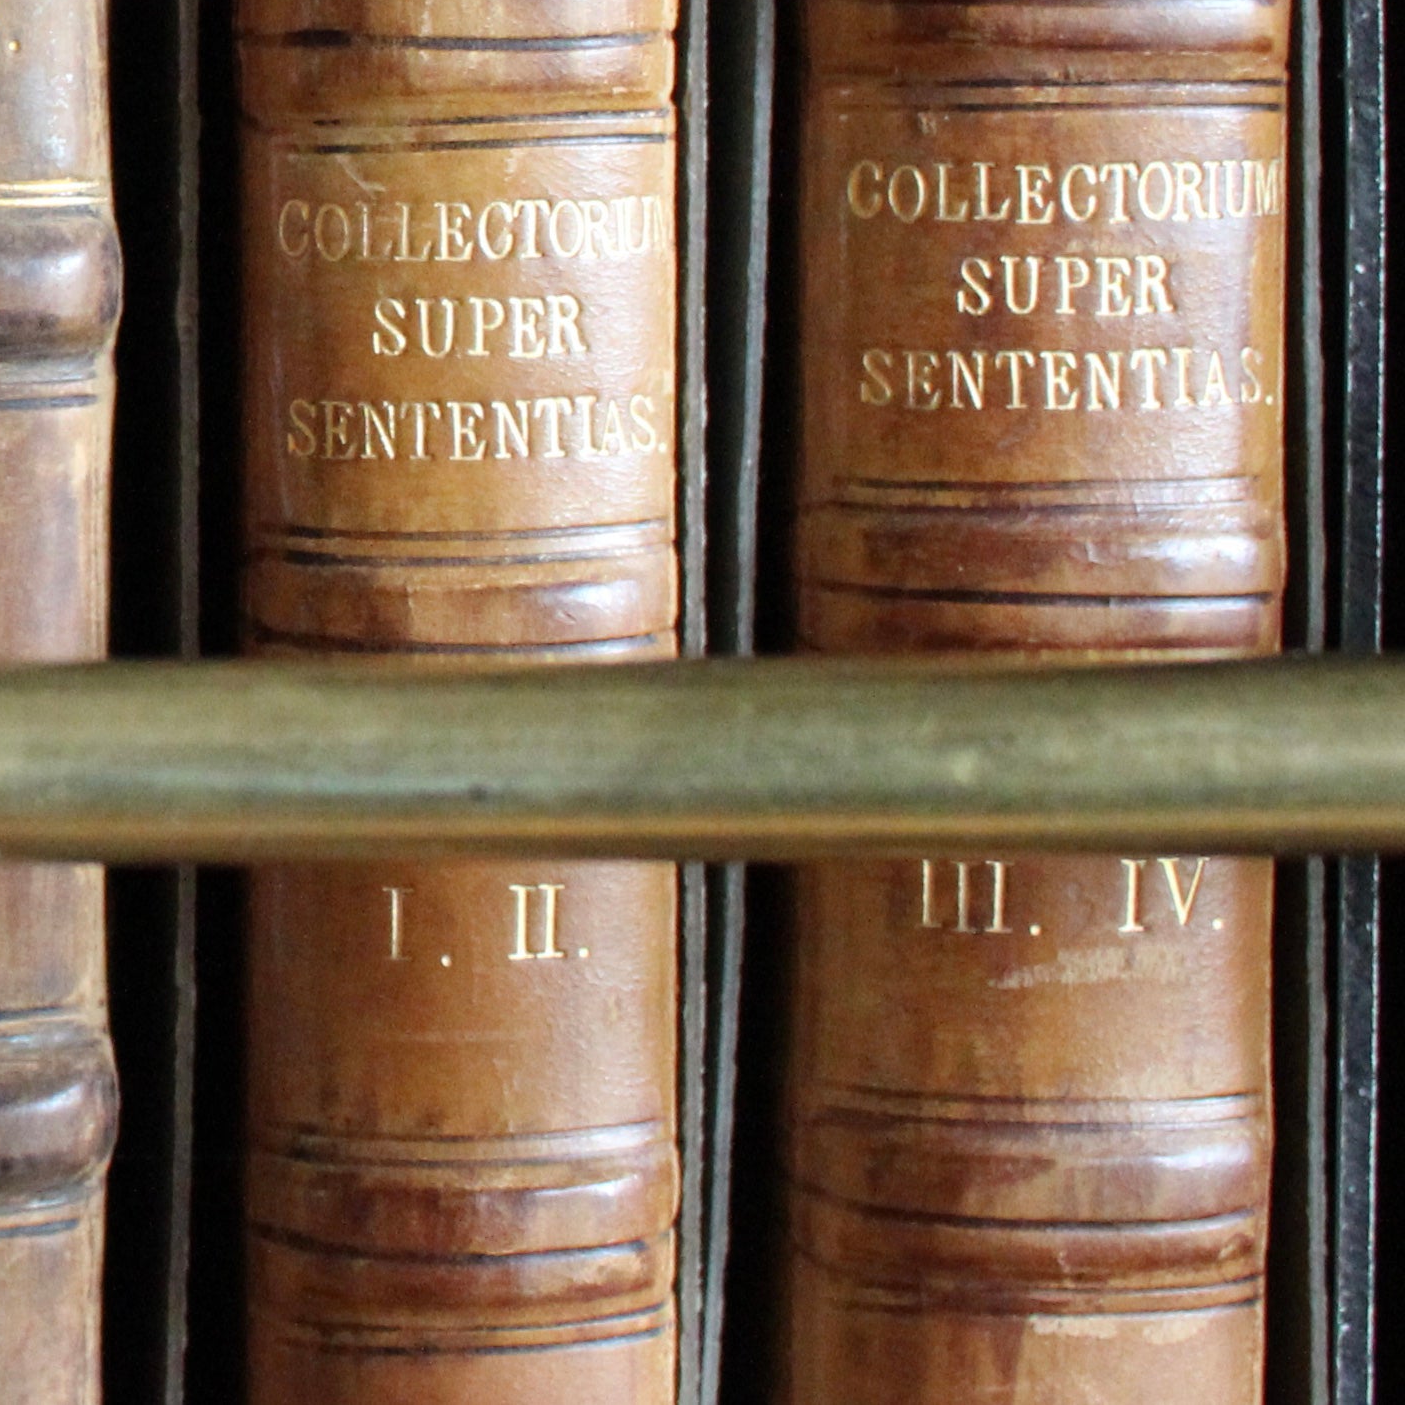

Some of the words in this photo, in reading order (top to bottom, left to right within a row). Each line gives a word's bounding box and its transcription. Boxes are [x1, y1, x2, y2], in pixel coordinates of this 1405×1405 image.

[846, 158, 1283, 226] COLLECTORIUM
[955, 254, 1174, 319] SUPER
[372, 295, 588, 359] SUPER
[860, 346, 1275, 412] SENTENTIAS.
[288, 393, 668, 461] SENTENTIAS.
[1117, 855, 1224, 934] IV.
